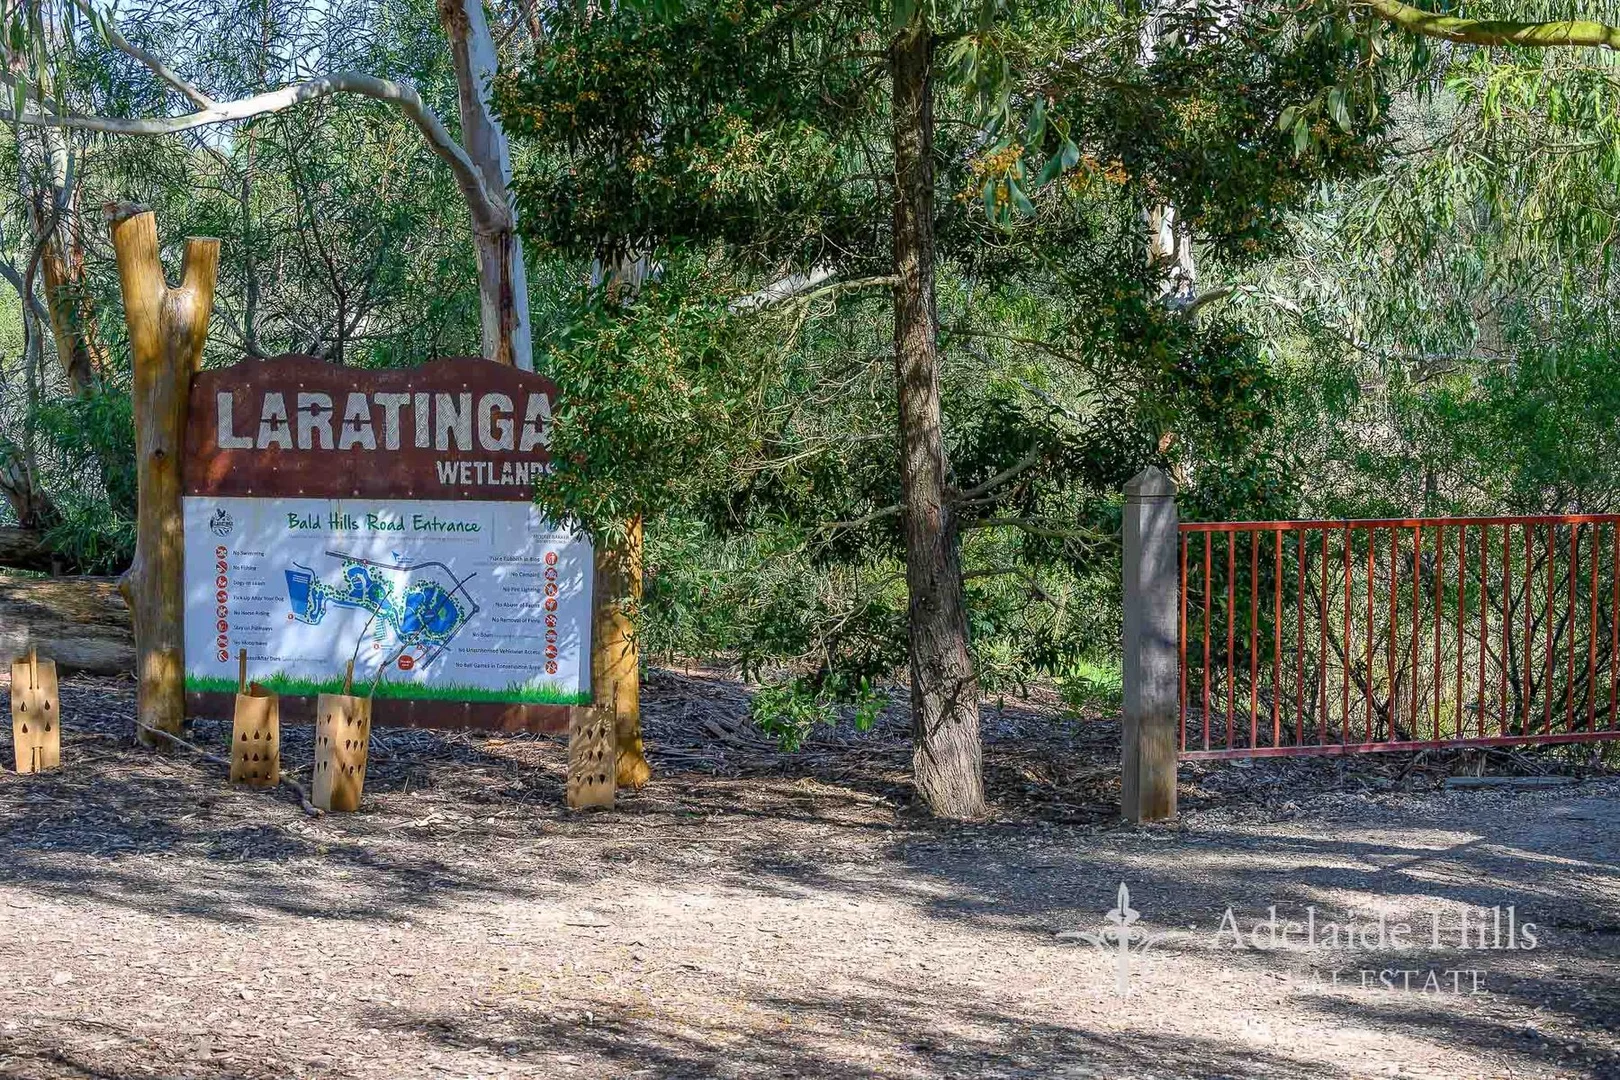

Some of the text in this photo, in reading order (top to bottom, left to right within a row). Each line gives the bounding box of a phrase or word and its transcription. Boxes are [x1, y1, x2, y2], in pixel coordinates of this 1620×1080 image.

[216, 391, 553, 452] LARATINGA
[287, 512, 481, 532] Bald Hills Road Entrance
